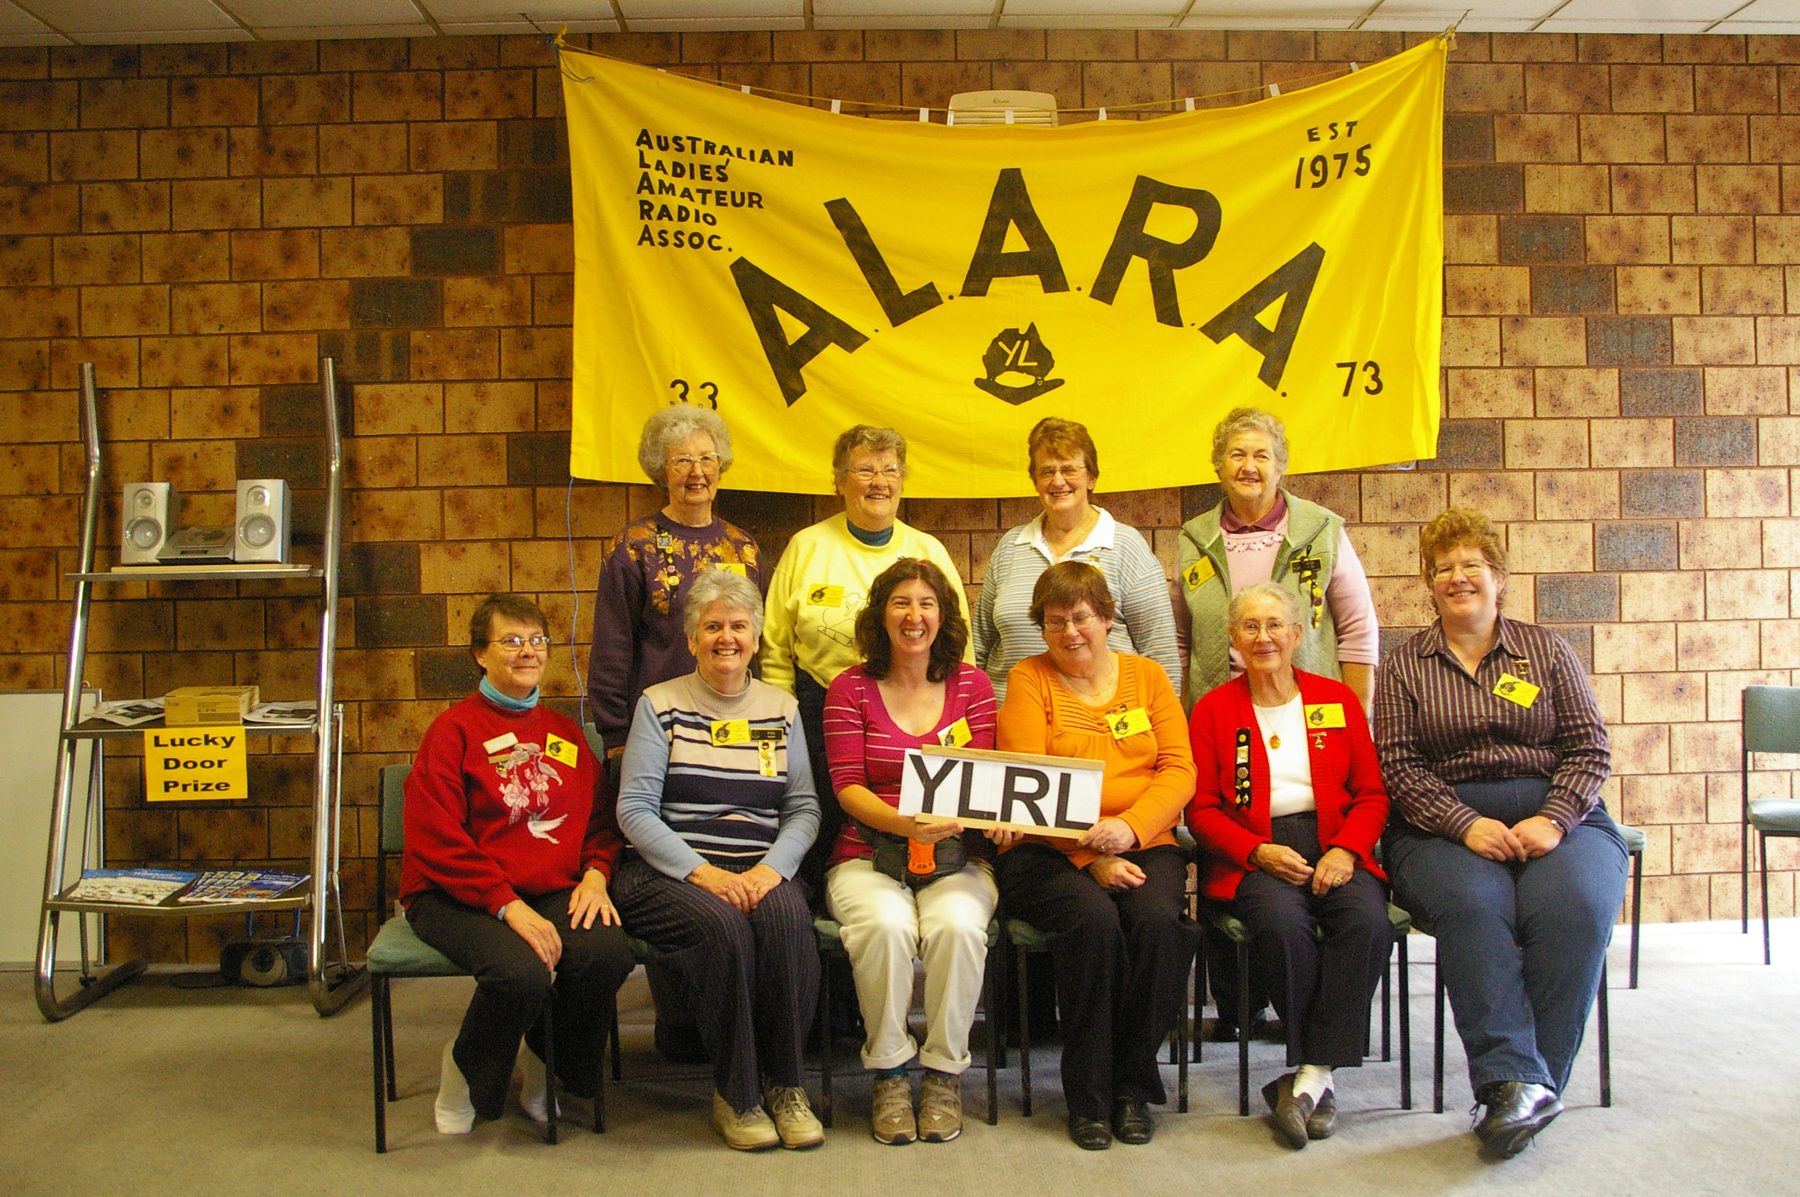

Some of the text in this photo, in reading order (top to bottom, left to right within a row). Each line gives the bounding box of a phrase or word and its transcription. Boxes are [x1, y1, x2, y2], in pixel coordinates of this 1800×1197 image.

[1307, 121, 1358, 142] EST
[635, 128, 794, 167] AUSTRALIAN
[1294, 143, 1372, 190] 1975
[636, 171, 764, 209] AMATEUR
[638, 199, 718, 226] RADIO
[637, 223, 733, 253] ASSOC.
[997, 339, 1038, 367] YL
[1336, 360, 1384, 398] 73
[670, 378, 719, 412] 33
[153, 733, 236, 749] Lucky
[163, 757, 228, 771] Door
[163, 779, 231, 793] Prize
[908, 753, 1095, 831] YLRL
